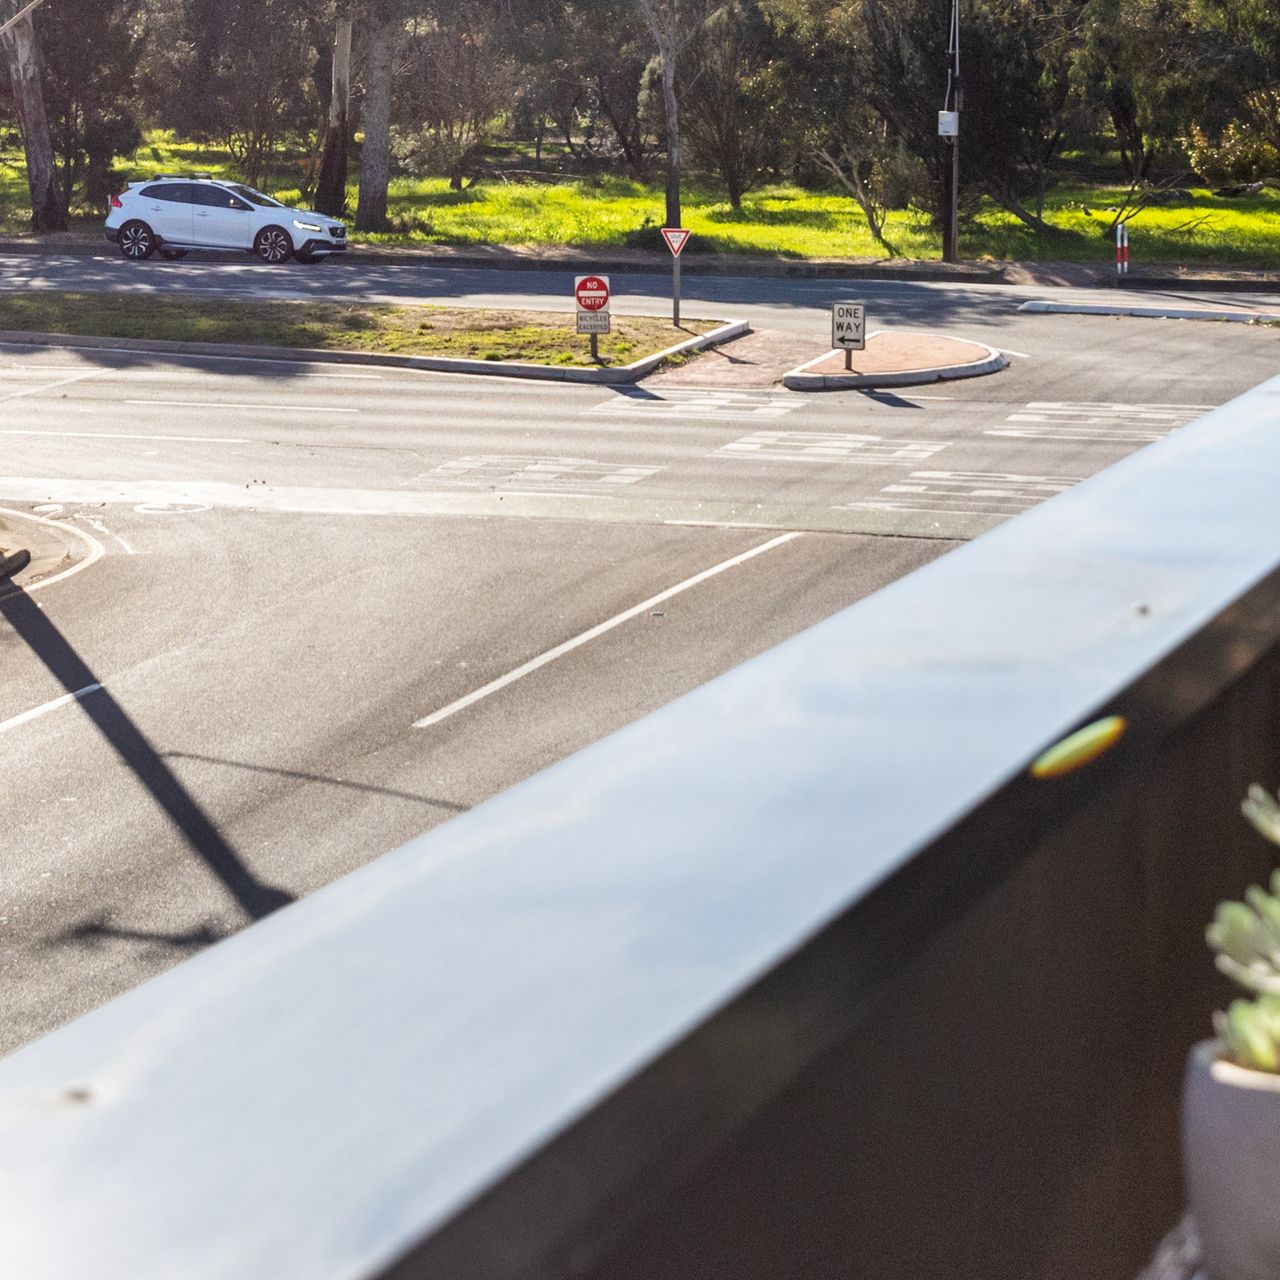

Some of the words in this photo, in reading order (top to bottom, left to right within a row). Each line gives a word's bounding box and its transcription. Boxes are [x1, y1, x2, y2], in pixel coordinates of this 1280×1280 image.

[586, 281, 598, 289] NO
[581, 297, 605, 306] ENTRY
[837, 307, 860, 319] ONE
[835, 321, 861, 332] WAY
